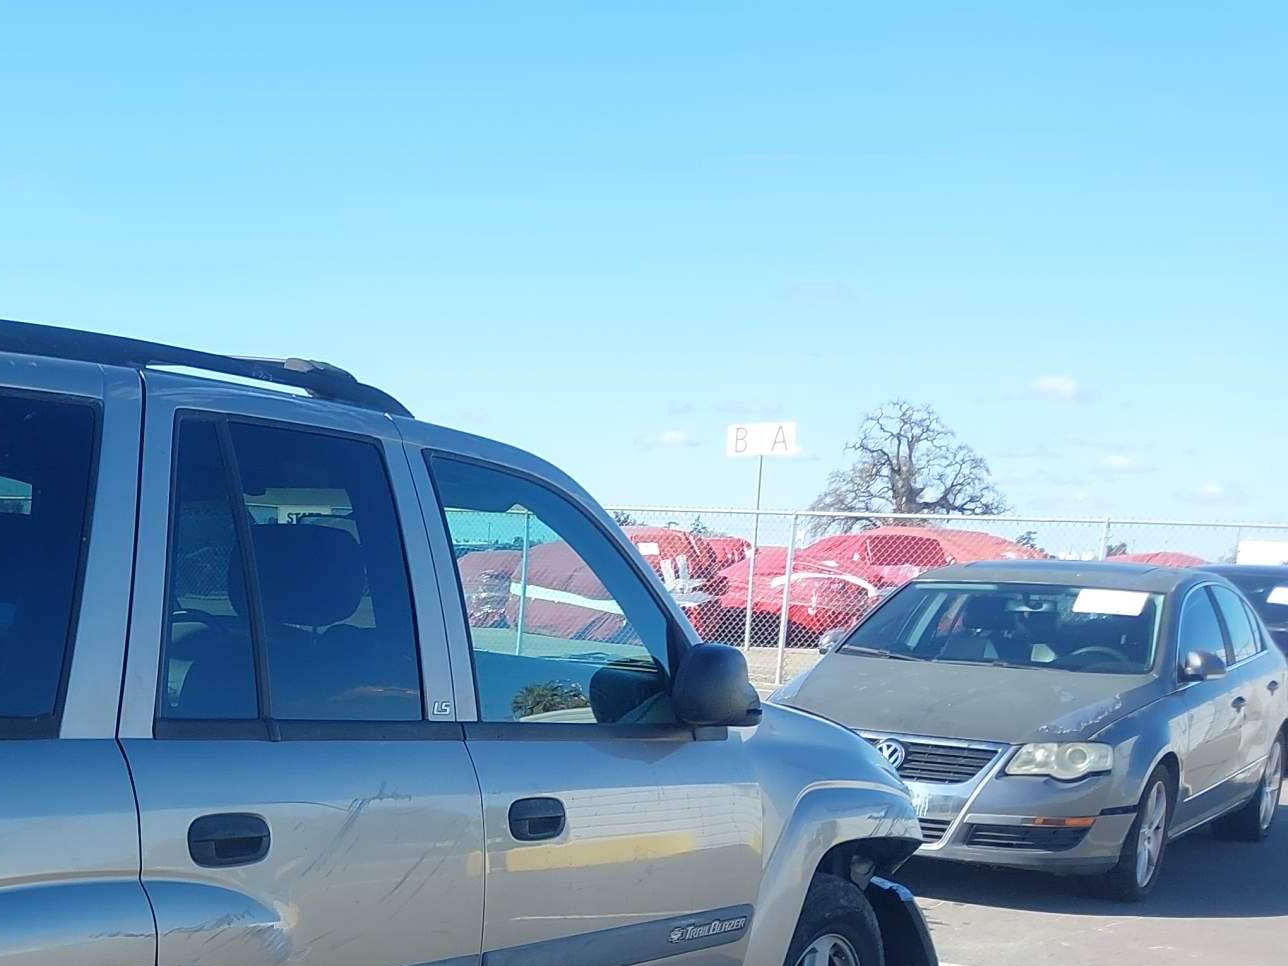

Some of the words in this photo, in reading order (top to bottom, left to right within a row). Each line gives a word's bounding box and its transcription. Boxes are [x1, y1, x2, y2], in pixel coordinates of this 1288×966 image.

[734, 427, 748, 453] B
[771, 425, 788, 452] A
[433, 702, 451, 715] LS
